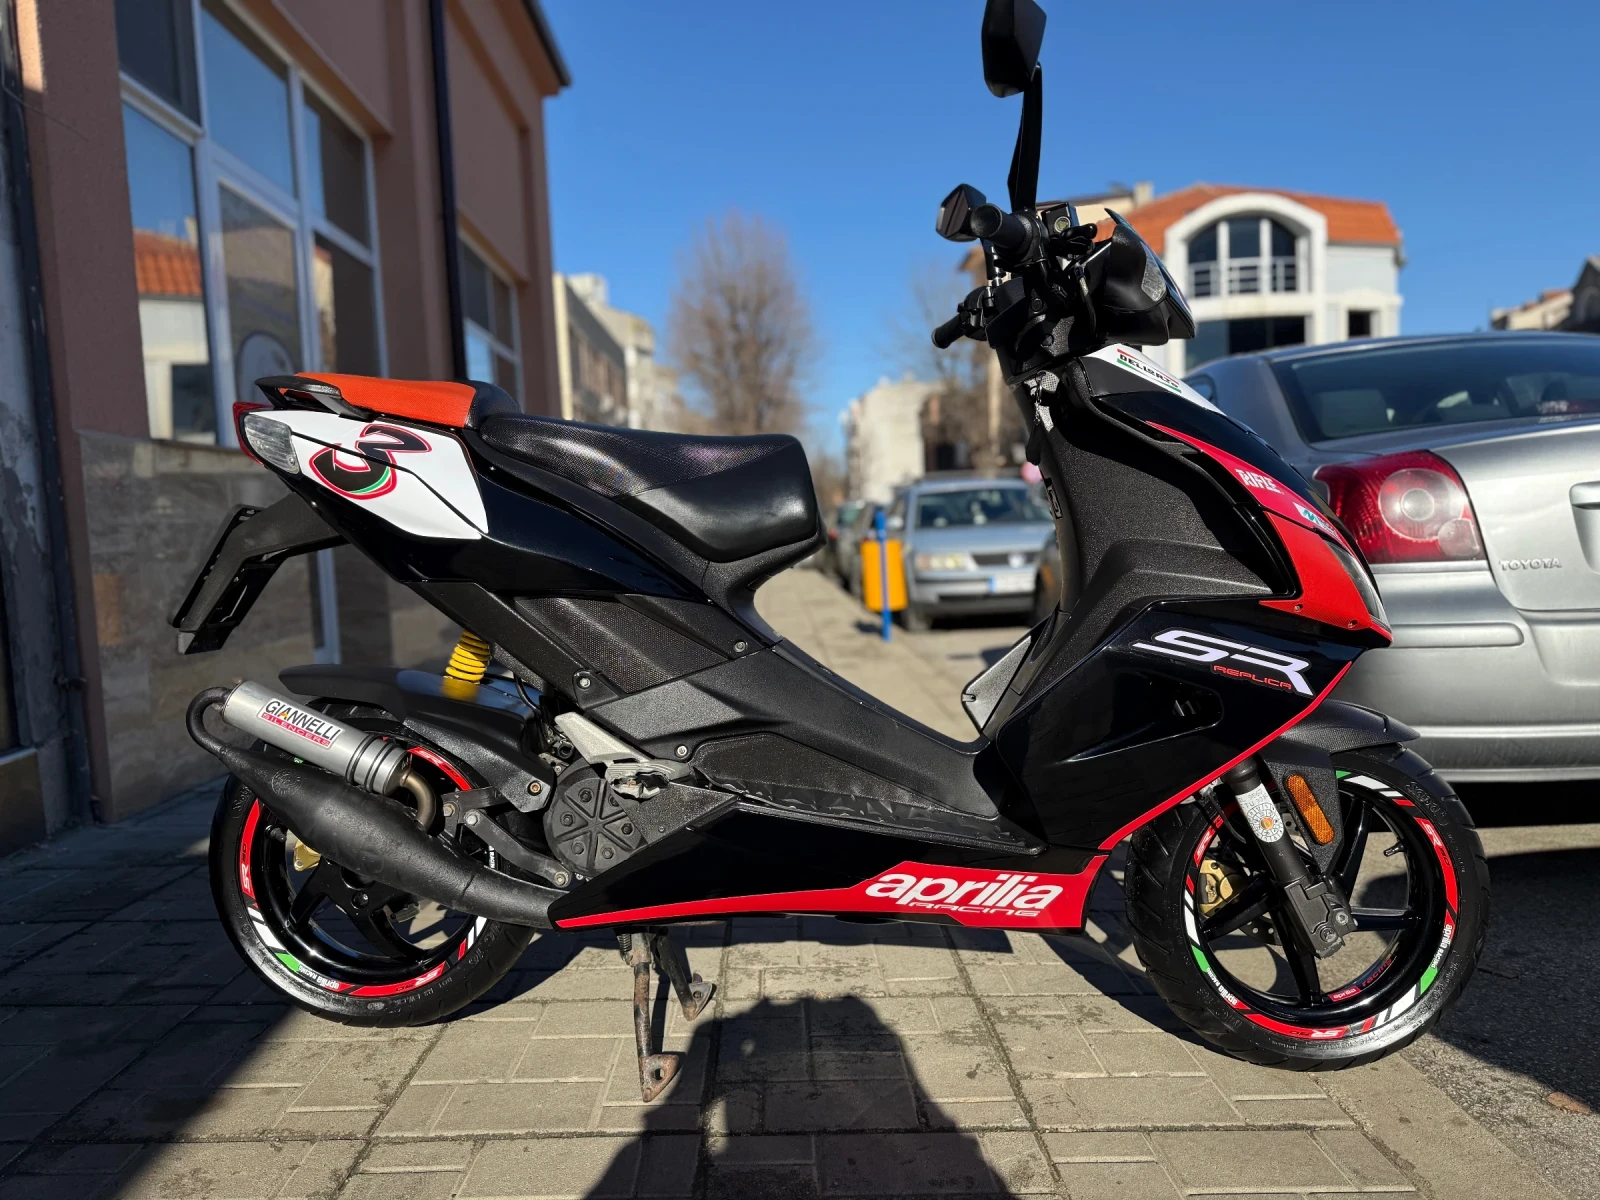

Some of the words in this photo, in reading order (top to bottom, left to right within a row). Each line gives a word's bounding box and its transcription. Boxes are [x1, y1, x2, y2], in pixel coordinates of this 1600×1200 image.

[1499, 557, 1562, 571] TOYOTA
[1132, 629, 1314, 696] SR
[1213, 664, 1292, 690] REPLICA
[261, 712, 331, 747] SILENCERS
[265, 700, 343, 741] GIANNELLI
[1421, 822, 1442, 849] SR
[241, 863, 251, 893] SR
[865, 873, 1064, 910] aprilia
[908, 901, 1040, 917] RACING
[1439, 924, 1453, 949] aprilia
[1430, 947, 1445, 969] RACING
[298, 964, 318, 980] RACING
[316, 976, 340, 990] aprilia
[1206, 967, 1221, 987] RACING
[1333, 988, 1357, 999] aprilia
[1362, 958, 1392, 987] racing
[1218, 985, 1238, 1006] aprilia
[1311, 1029, 1344, 1038] SR
